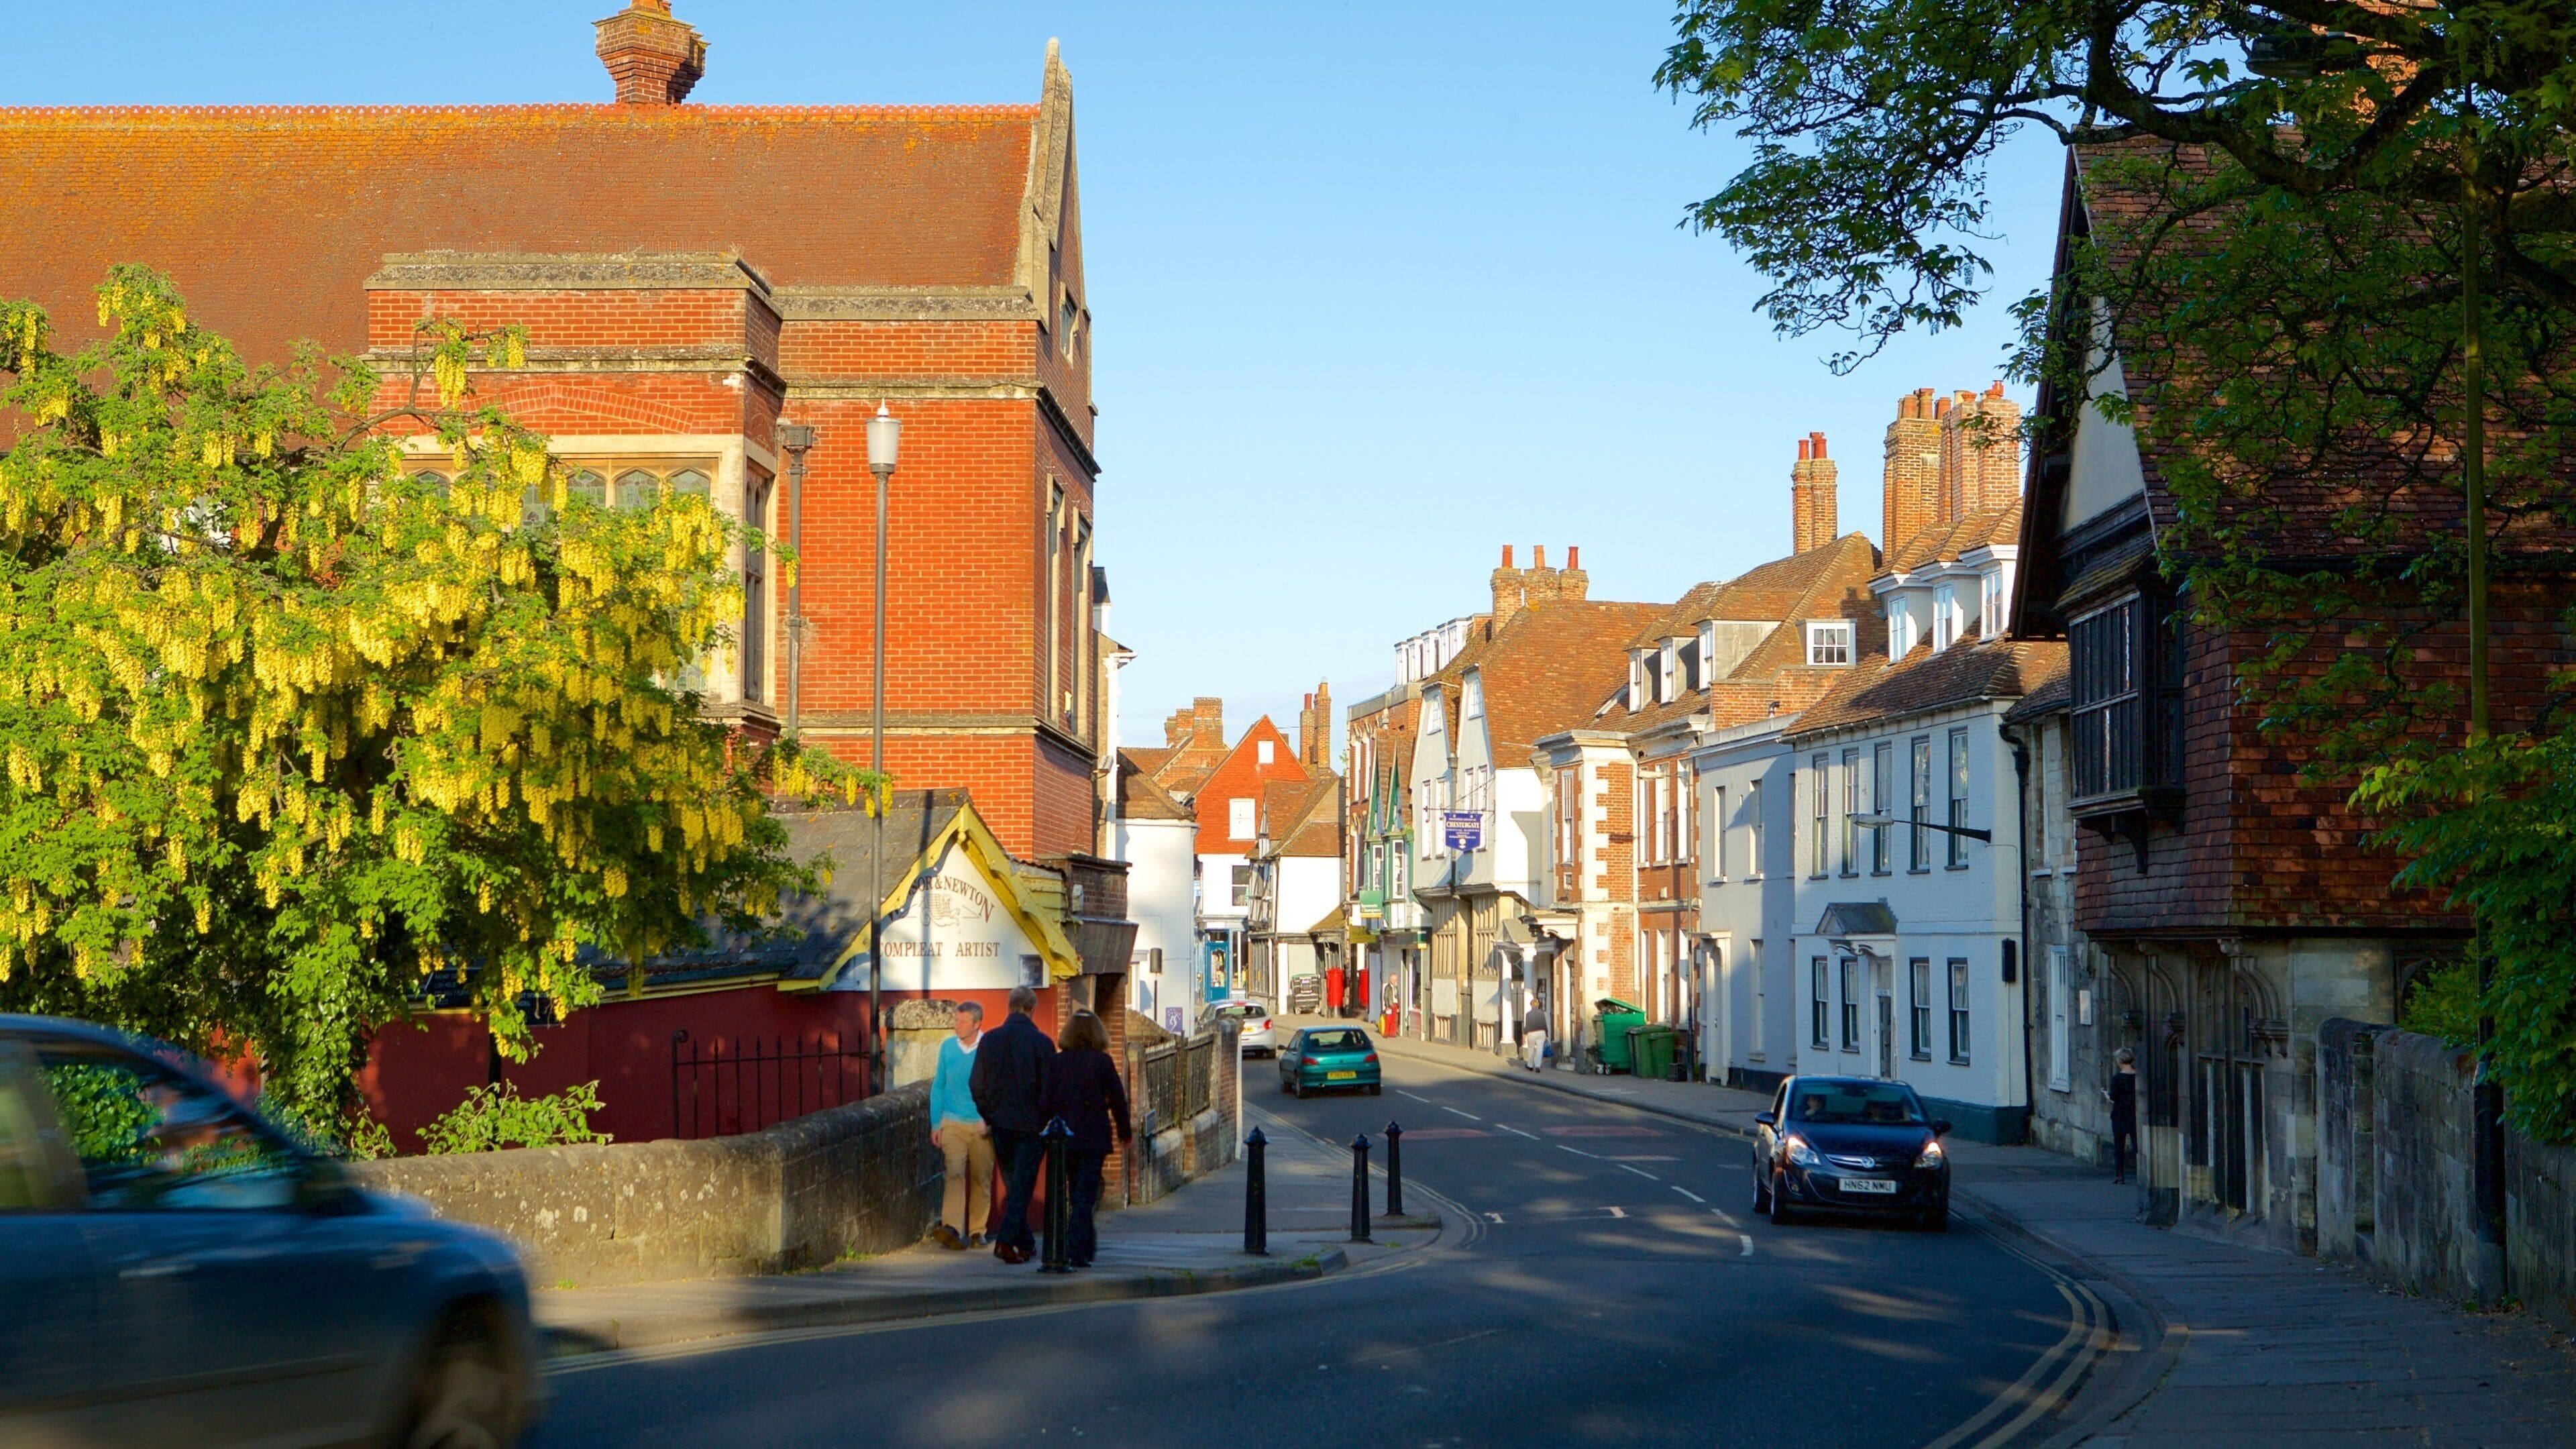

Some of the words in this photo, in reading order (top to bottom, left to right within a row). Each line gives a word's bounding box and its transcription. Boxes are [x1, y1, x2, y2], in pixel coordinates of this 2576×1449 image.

[945, 875, 995, 923] NEWTON
[955, 942, 1000, 957] ARTIST
[1844, 1180, 1870, 1190] HN62
[1872, 1181, 1892, 1191] NMU
